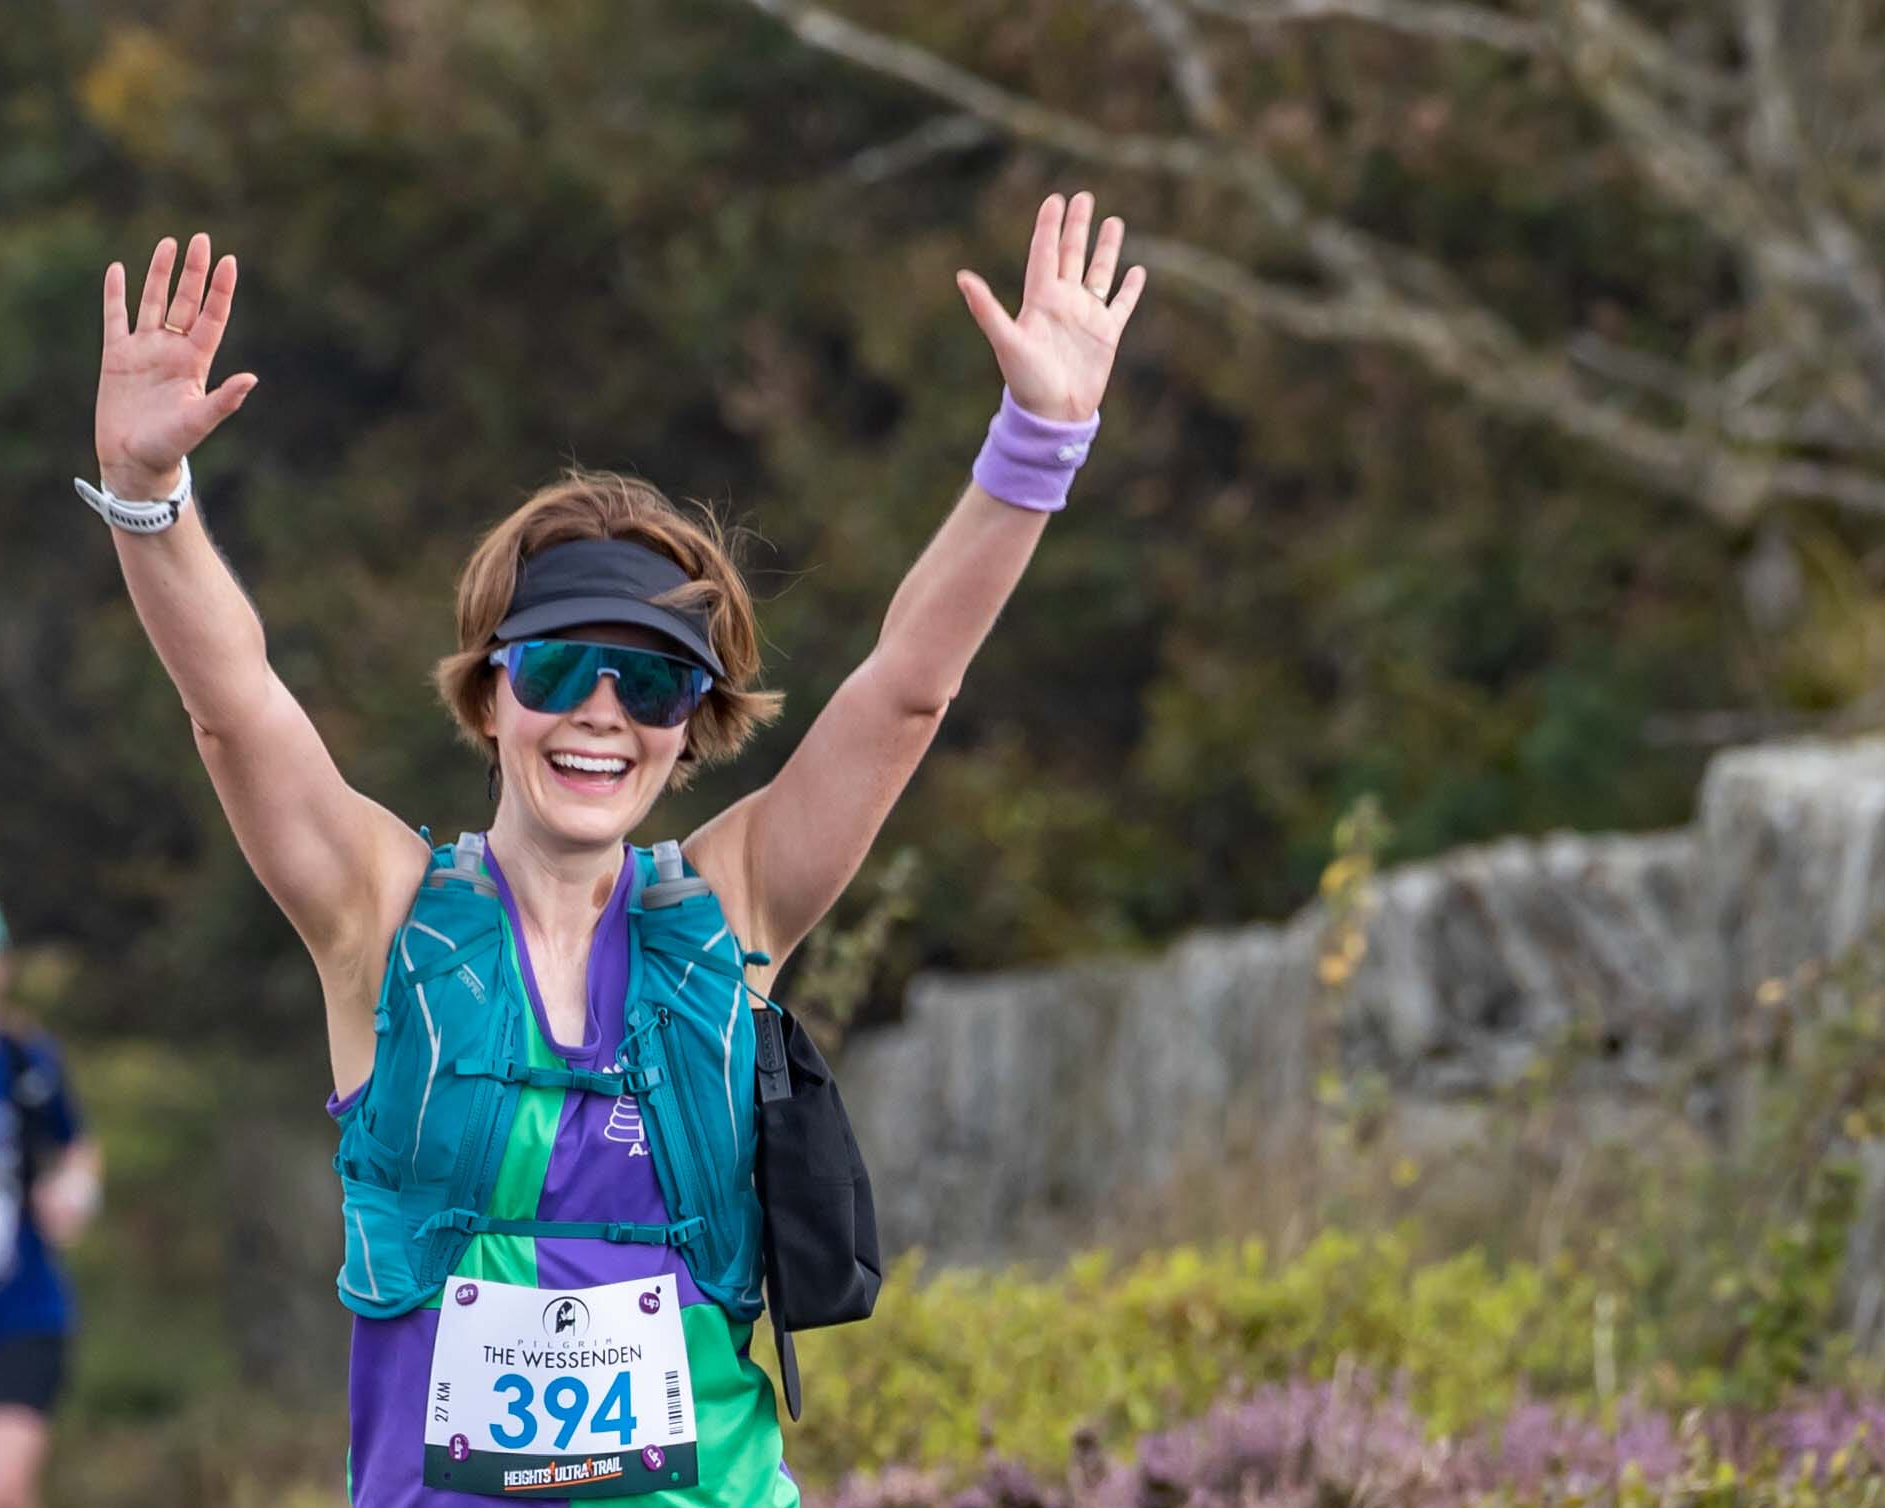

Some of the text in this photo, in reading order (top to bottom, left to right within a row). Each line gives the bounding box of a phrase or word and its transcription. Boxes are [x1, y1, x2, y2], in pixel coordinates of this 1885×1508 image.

[628, 1142, 650, 1157] A.
[483, 1343, 643, 1369] THE WESSENDEN
[517, 1337, 613, 1349] PILGRIM
[434, 1382, 452, 1423] 27 KM
[489, 1371, 637, 1450] 394
[504, 1456, 623, 1487] HEIGHTS ULTRA TRAIL
